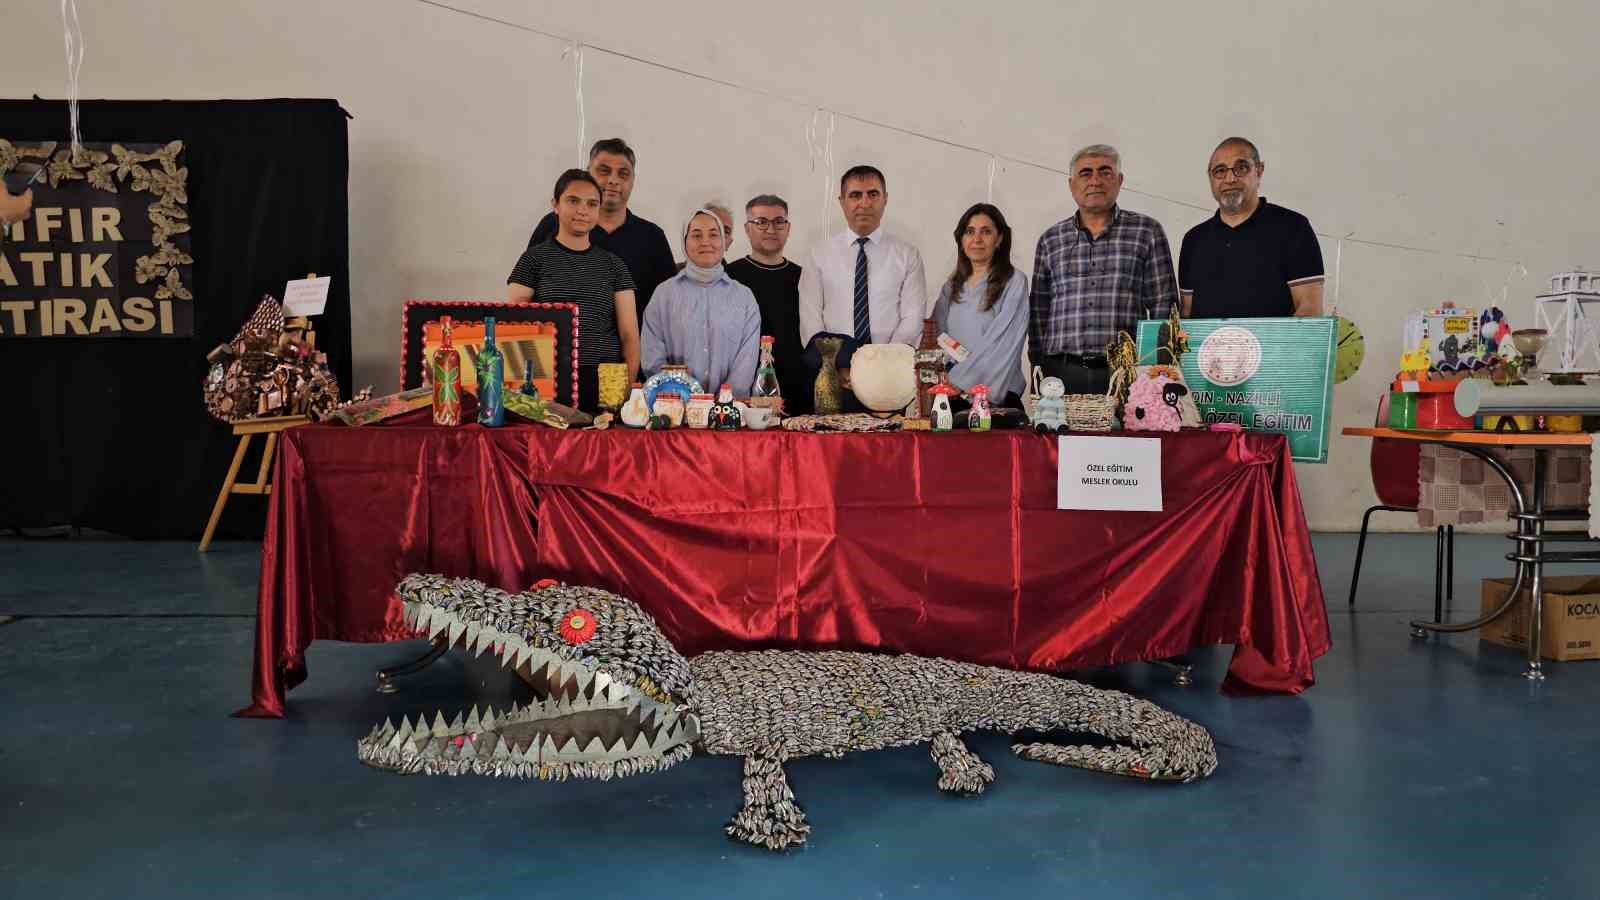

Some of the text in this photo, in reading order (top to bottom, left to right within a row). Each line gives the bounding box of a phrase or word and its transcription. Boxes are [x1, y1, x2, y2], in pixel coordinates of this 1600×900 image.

[11, 207, 124, 241] IFIR
[0, 252, 115, 288] ATIK
[0, 297, 174, 337] TIRASI
[1081, 477, 1139, 487] MESLEK OKULU
[1086, 463, 1134, 473] ÖZEL EĞİTİM
